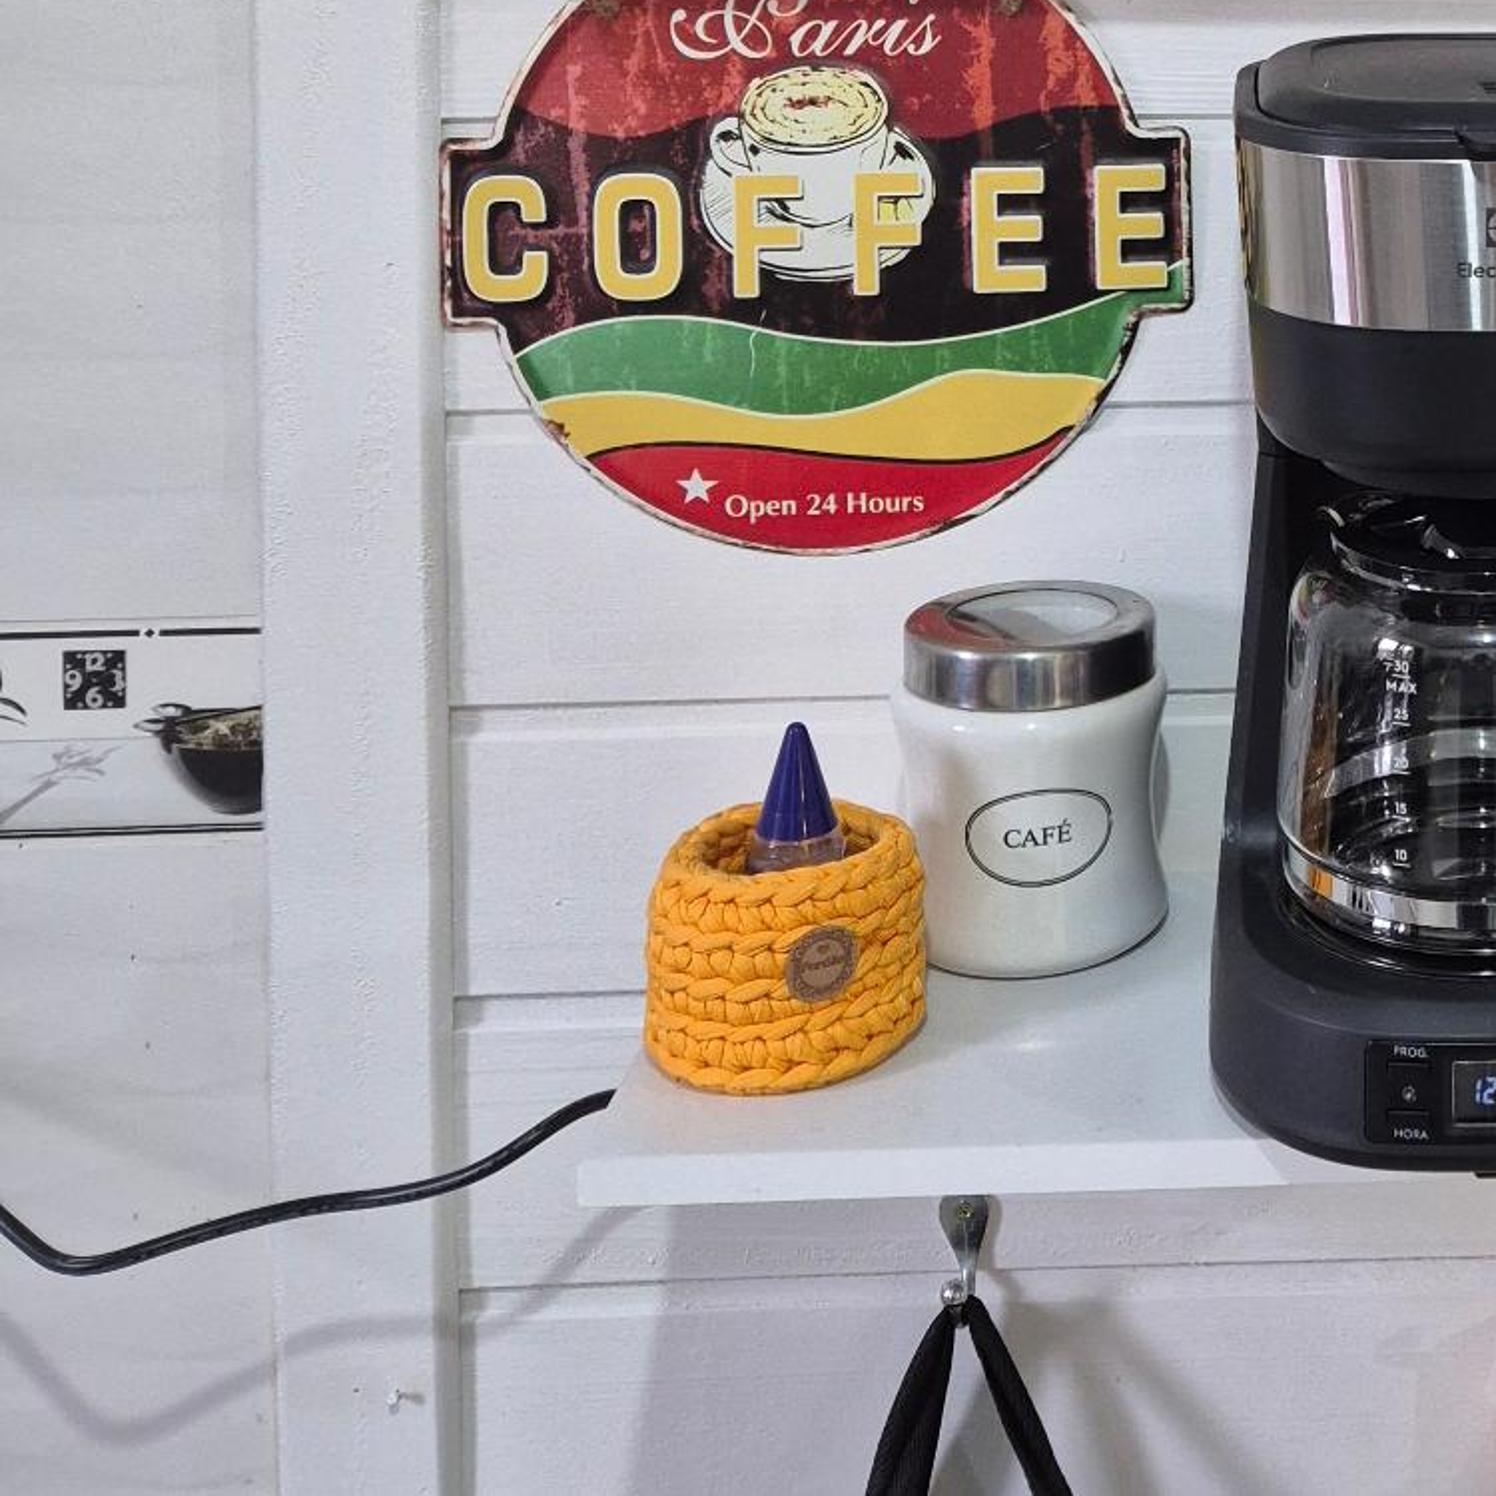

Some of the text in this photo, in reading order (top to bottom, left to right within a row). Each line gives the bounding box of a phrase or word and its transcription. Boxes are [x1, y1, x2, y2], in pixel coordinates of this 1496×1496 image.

[461, 163, 1169, 304] COFFEE
[724, 492, 925, 524] Open 24 Hours
[65, 669, 82, 692] 9
[1386, 678, 1418, 694] MAX
[85, 686, 105, 709] 6
[1393, 707, 1409, 721] 25
[1394, 801, 1407, 814] 15
[1003, 817, 1073, 848] CAFÉ
[1394, 849, 1408, 861] 10
[1393, 1127, 1429, 1140] HORA
